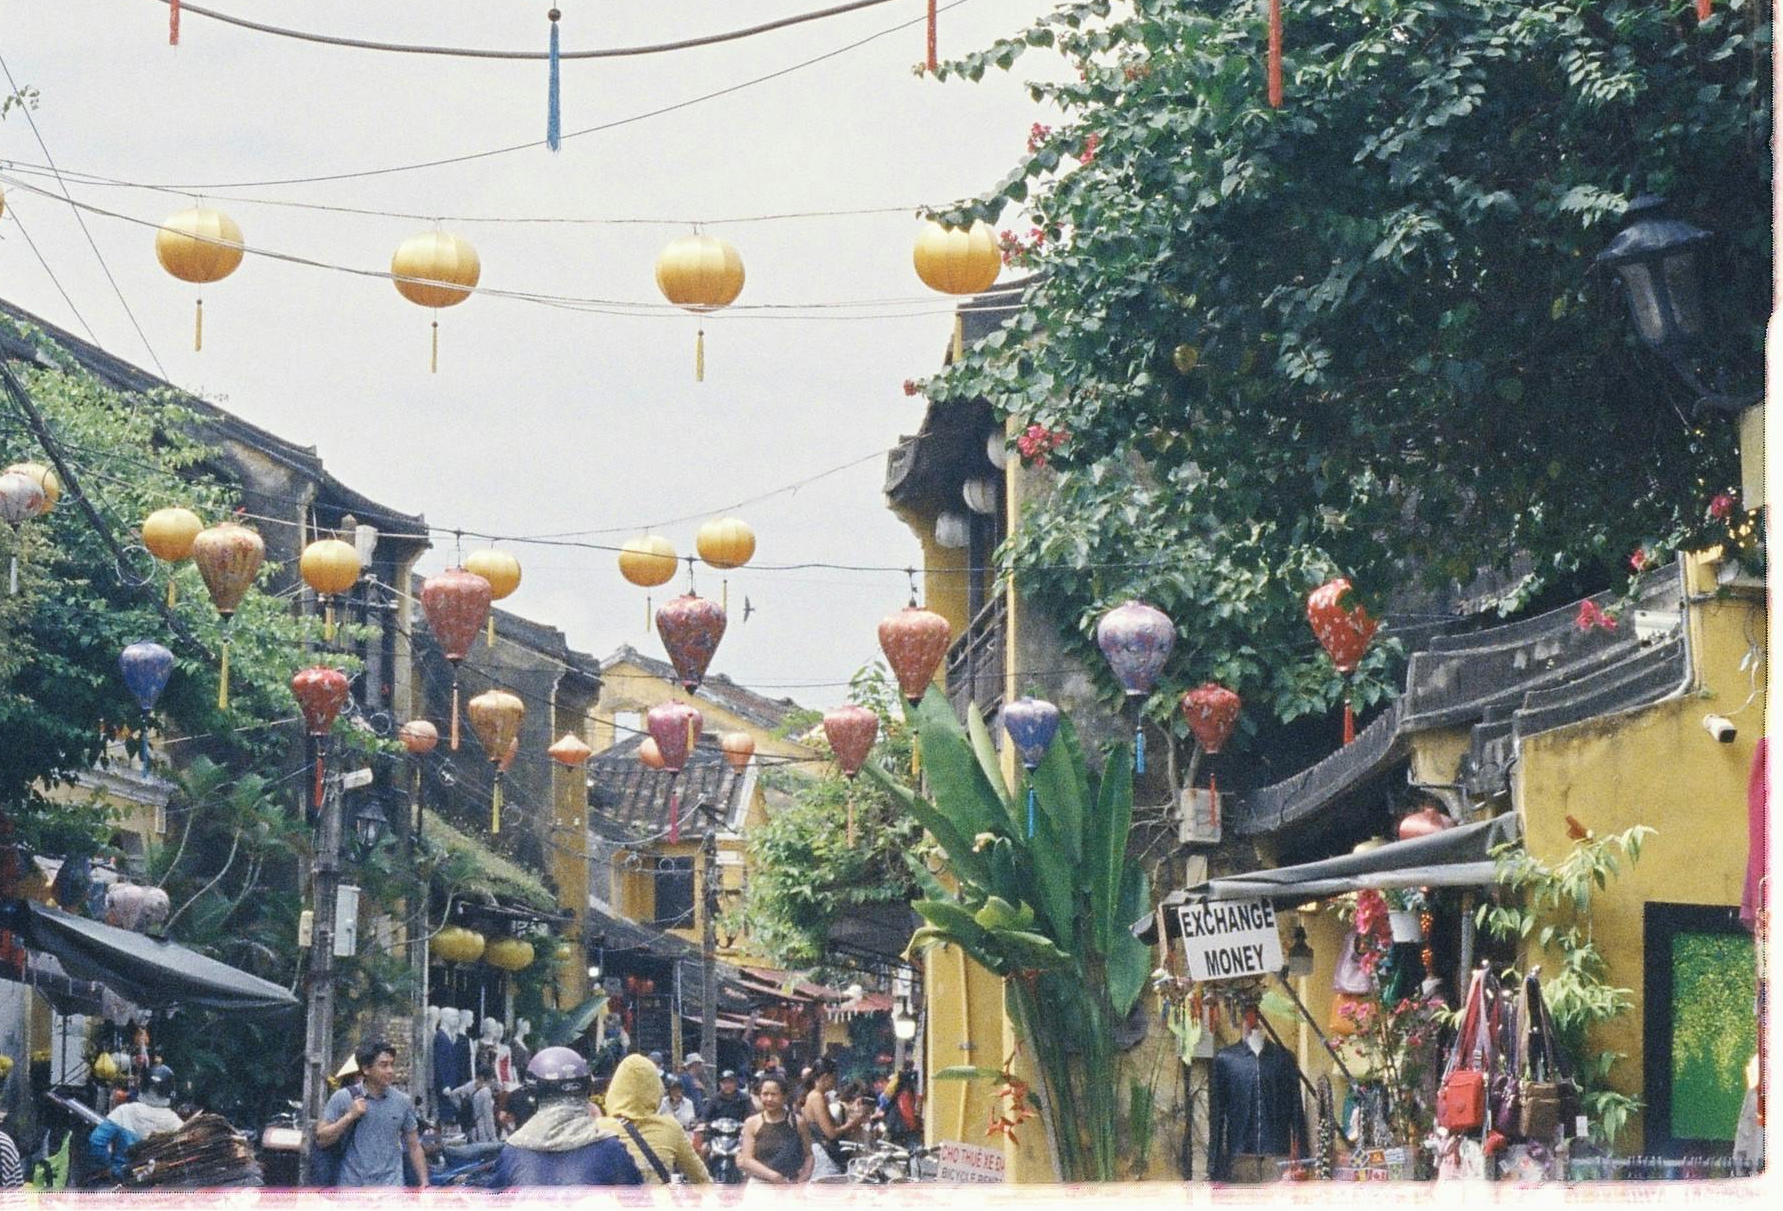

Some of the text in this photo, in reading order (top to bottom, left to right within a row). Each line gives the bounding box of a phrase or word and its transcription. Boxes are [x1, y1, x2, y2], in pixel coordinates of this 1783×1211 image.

[1181, 905, 1274, 938] EXCHANGE
[1204, 944, 1264, 976] MONEY
[941, 1145, 959, 1163] CHO
[984, 1154, 995, 1171] XE
